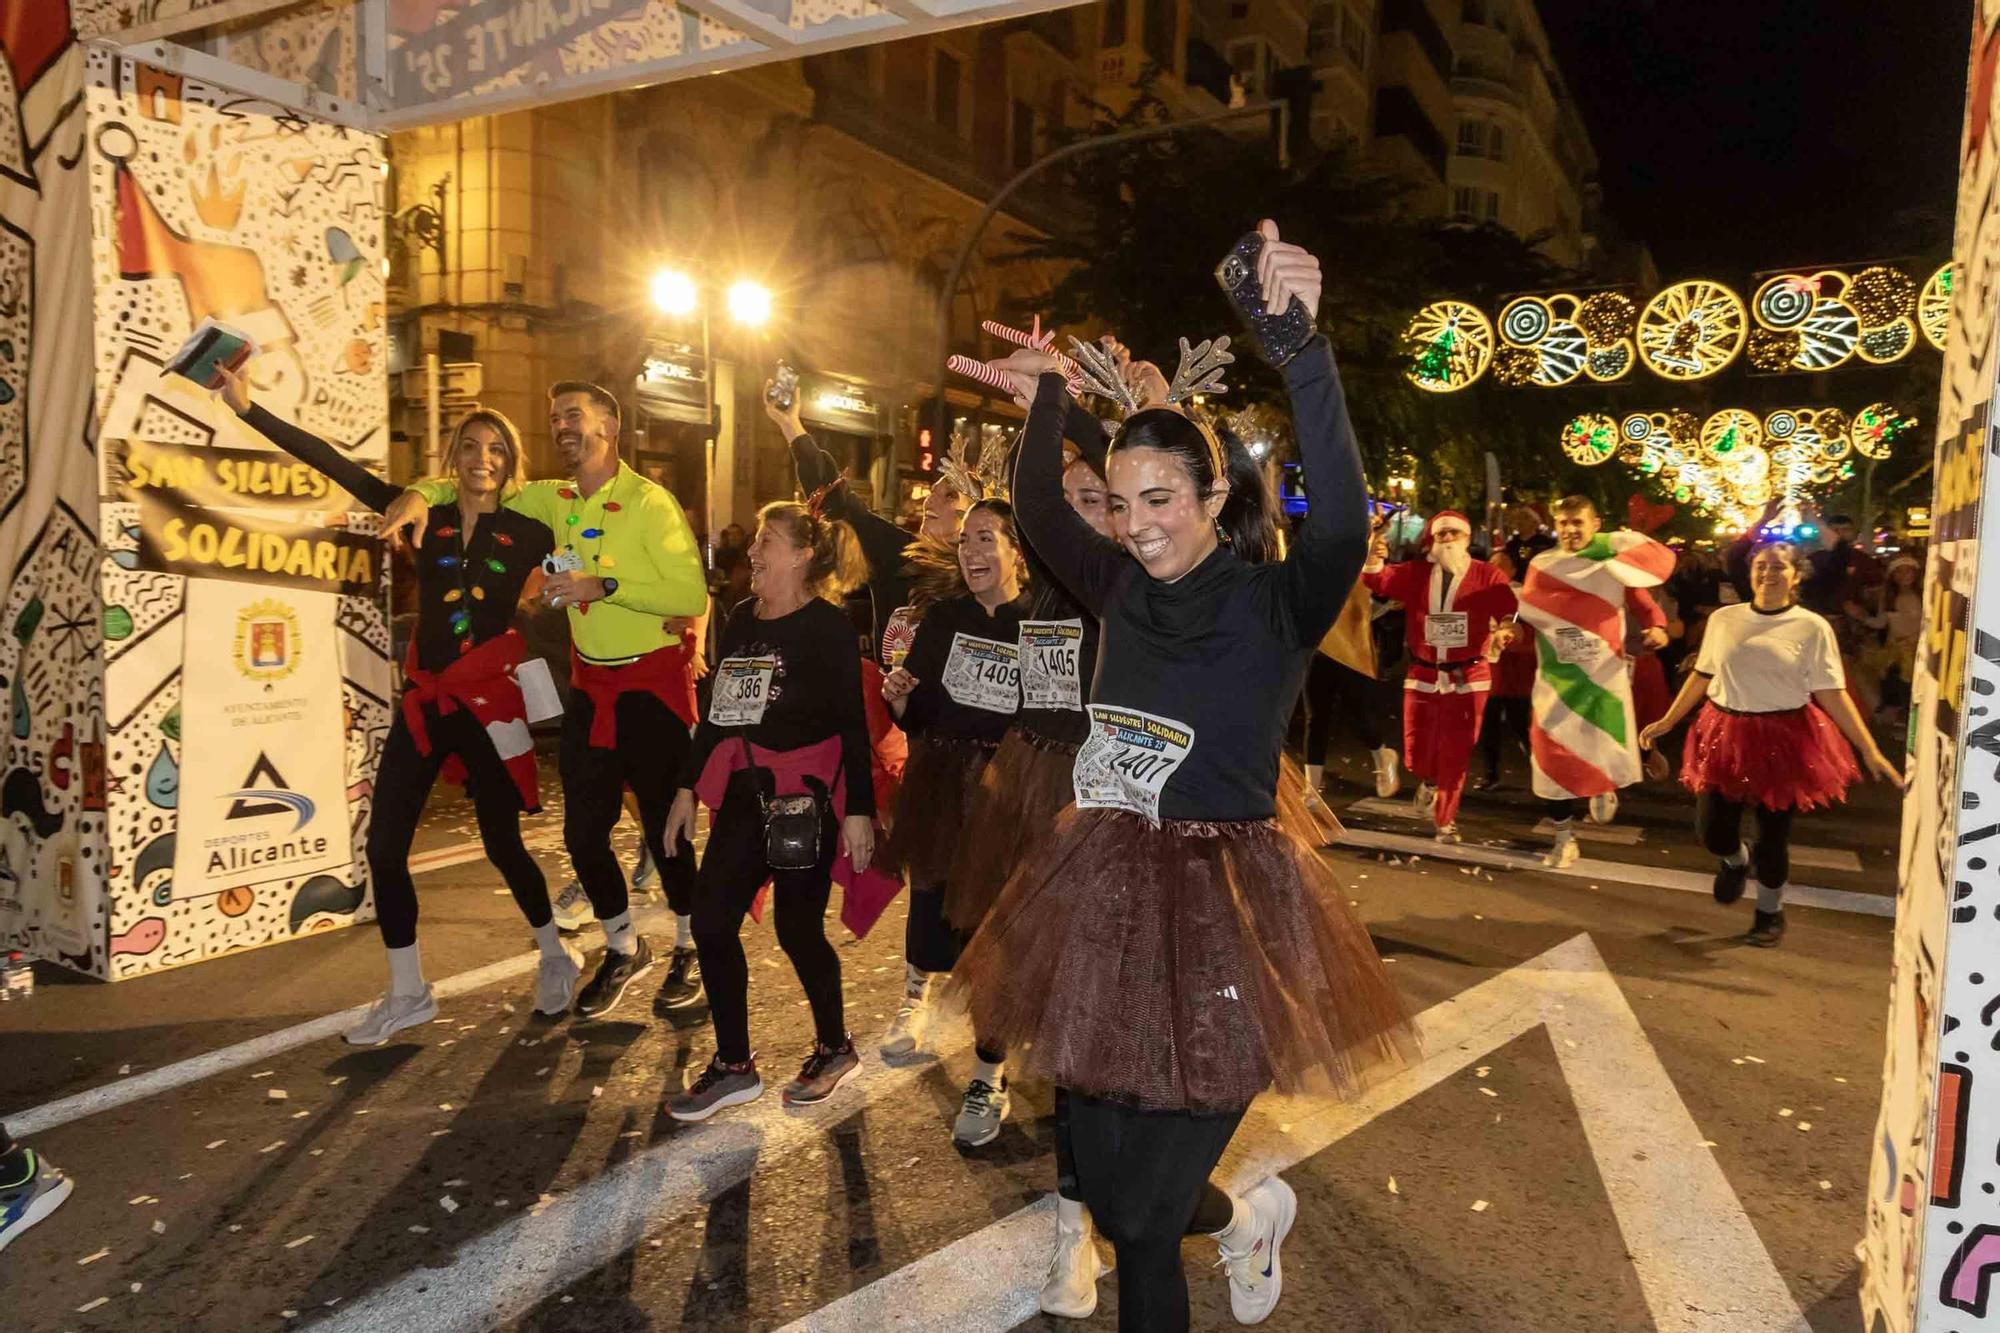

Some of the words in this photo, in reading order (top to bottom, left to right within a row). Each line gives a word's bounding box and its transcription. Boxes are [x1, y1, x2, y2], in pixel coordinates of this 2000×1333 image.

[126, 453, 205, 490] SAN
[162, 517, 373, 584] SOLIDARIA
[975, 660, 1021, 687] 1409
[1038, 648, 1075, 677] 1405
[737, 677, 762, 699] 386
[1094, 711, 1108, 721] SAN
[1110, 714, 1142, 729] SILVESTRE
[1146, 721, 1188, 747] SOLIDARIA
[1118, 730, 1154, 748] ALICANTE
[1109, 748, 1177, 784] 1407
[204, 831, 271, 849] DEPORTES
[206, 836, 328, 873] Alicante
